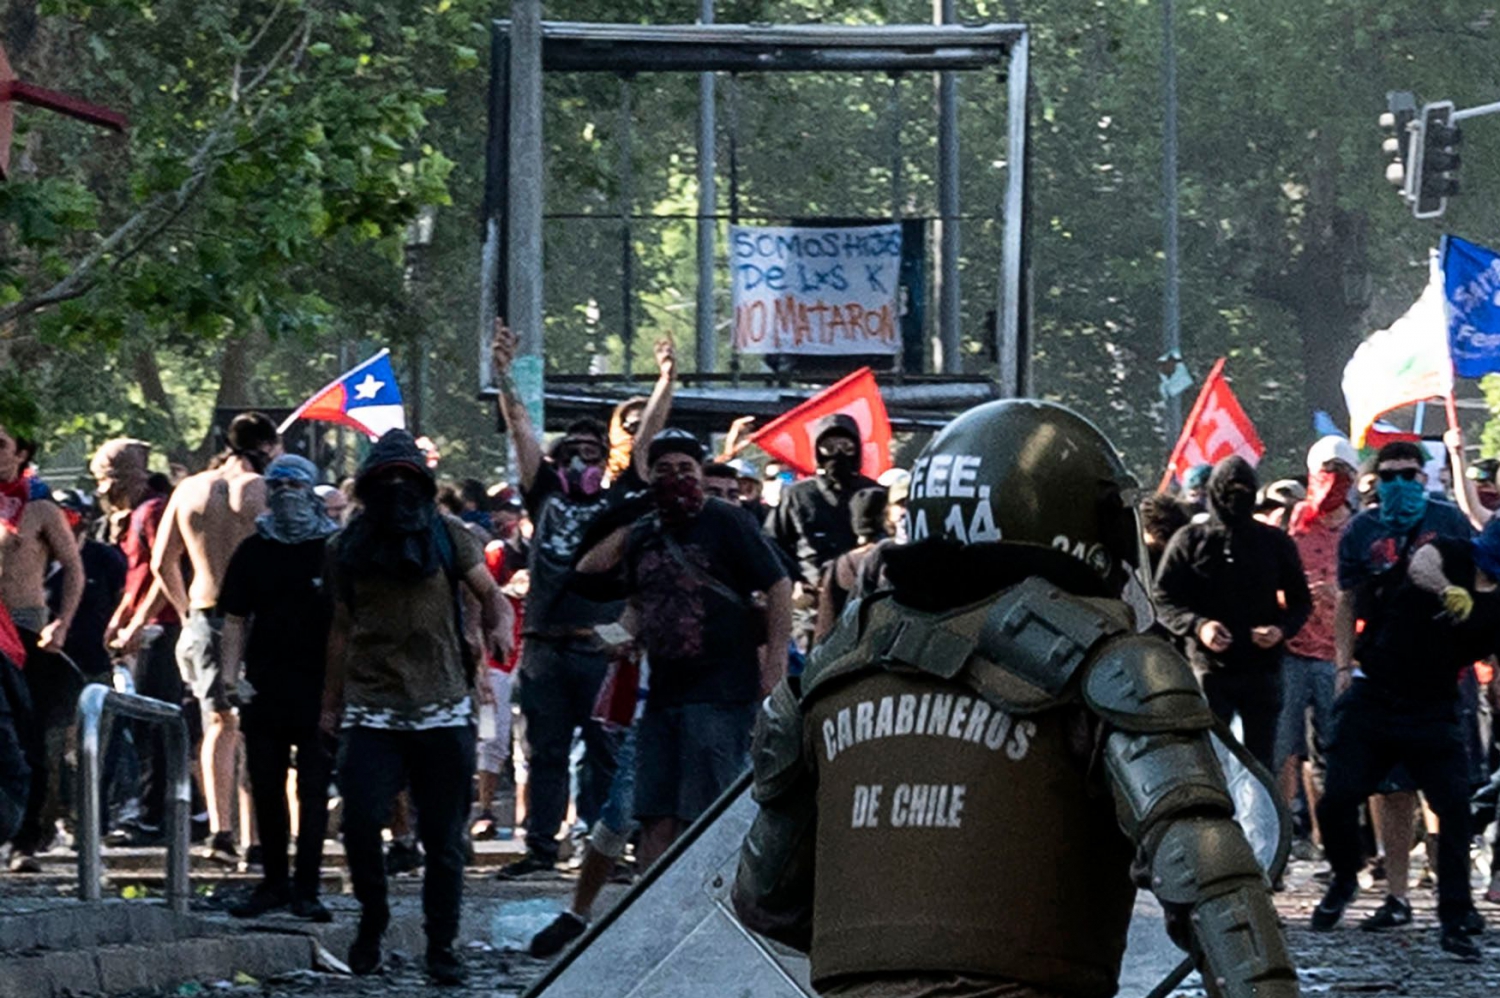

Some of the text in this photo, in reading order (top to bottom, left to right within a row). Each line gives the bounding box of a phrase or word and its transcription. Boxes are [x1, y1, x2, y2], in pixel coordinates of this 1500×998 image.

[865, 263, 888, 294] K
[822, 694, 1037, 761] CARABINEROS
[852, 783, 967, 828] DE CHILE
